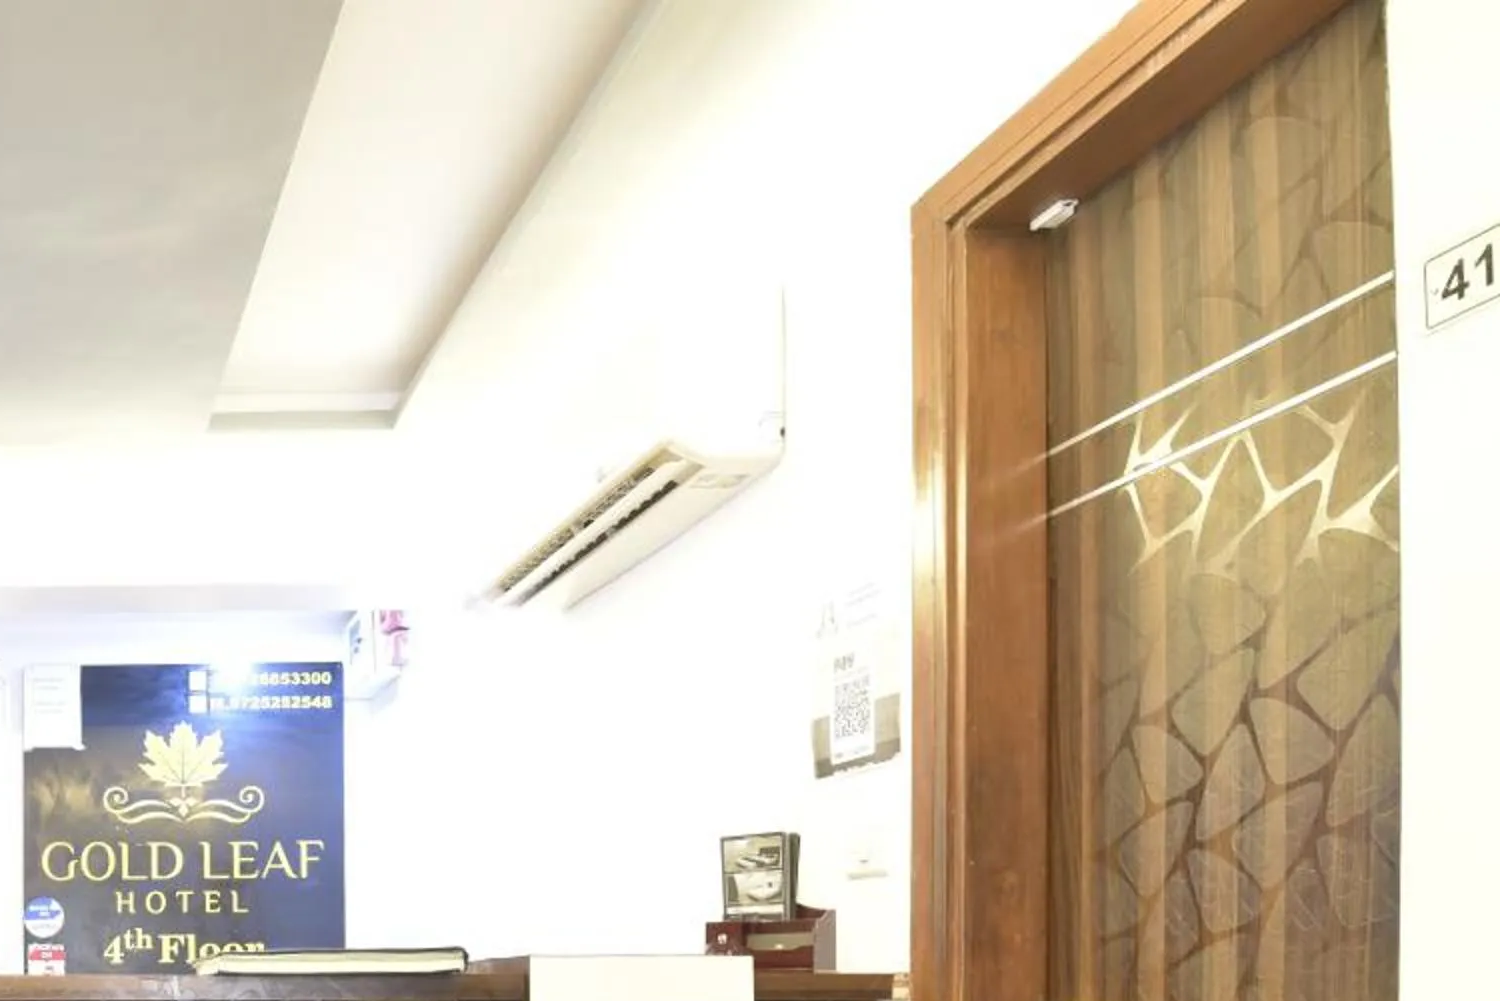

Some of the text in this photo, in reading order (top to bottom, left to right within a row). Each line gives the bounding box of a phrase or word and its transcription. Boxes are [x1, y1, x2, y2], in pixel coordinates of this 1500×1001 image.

[1440, 243, 1494, 300] 41
[41, 839, 325, 882] GOLD LEAF
[115, 889, 250, 914] HOTEL
[103, 927, 154, 965] 4th
